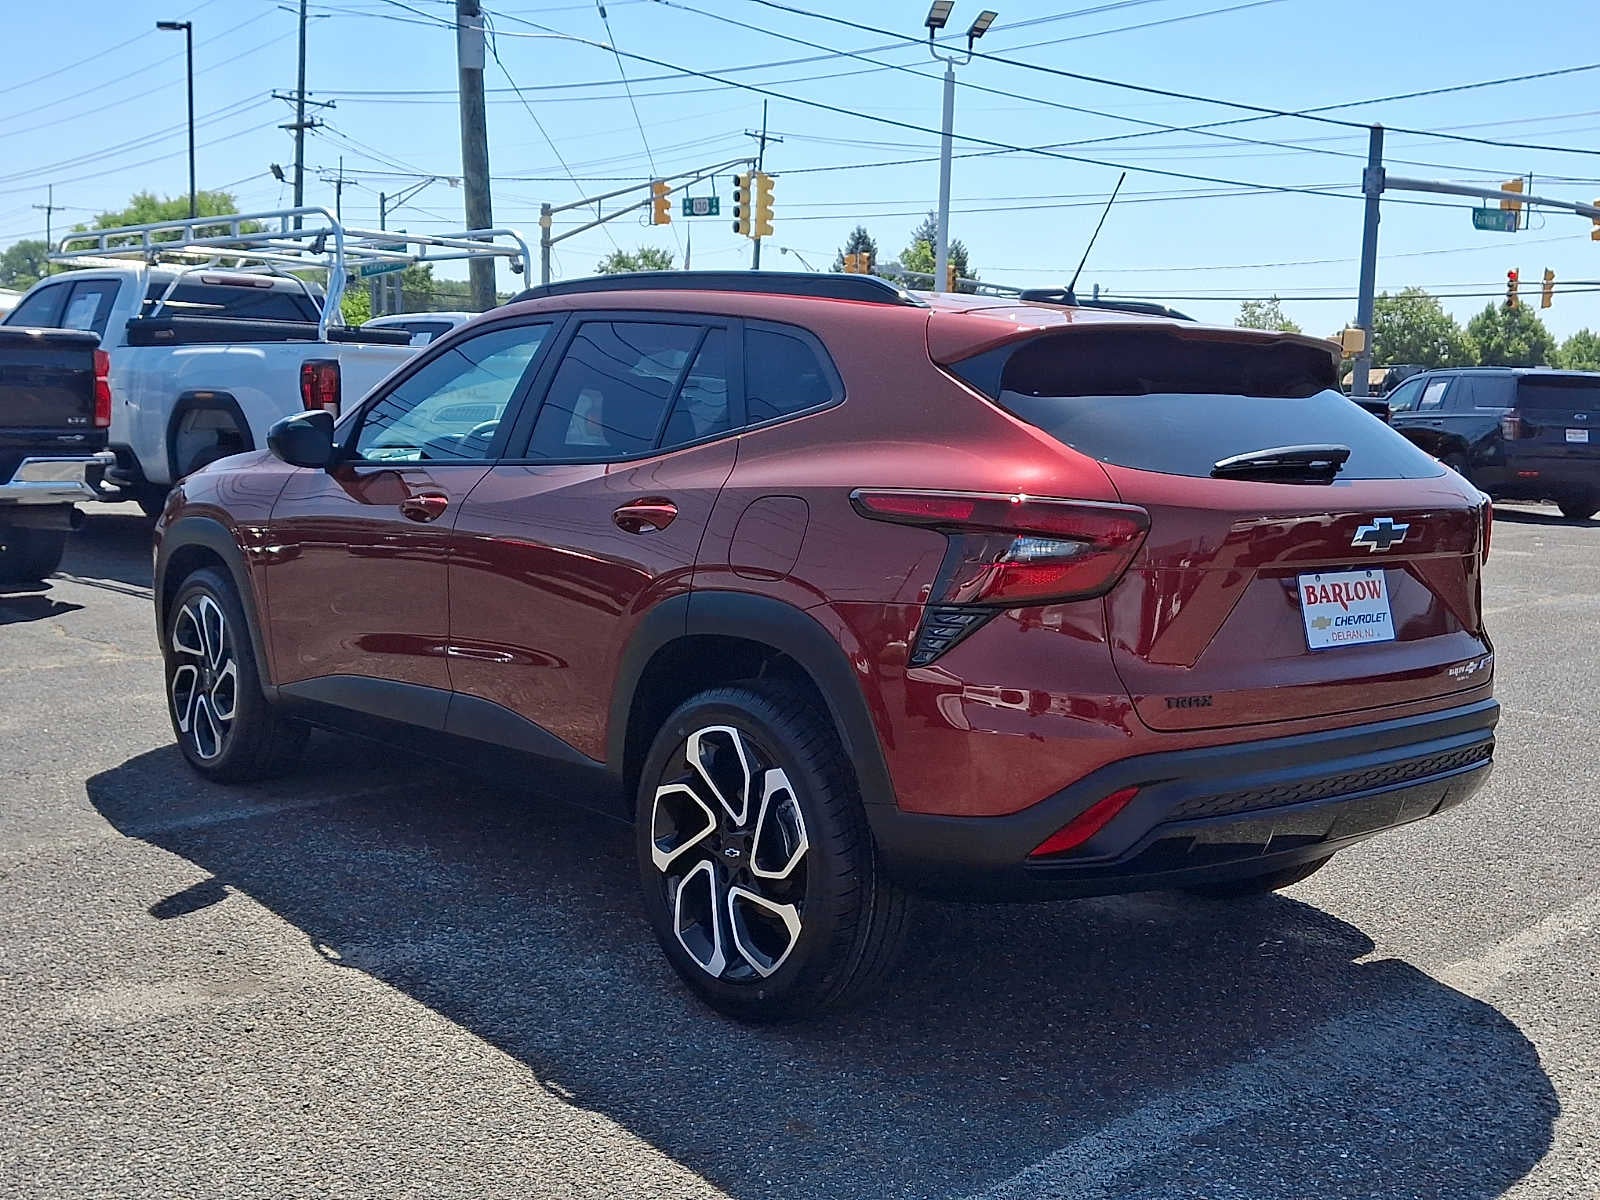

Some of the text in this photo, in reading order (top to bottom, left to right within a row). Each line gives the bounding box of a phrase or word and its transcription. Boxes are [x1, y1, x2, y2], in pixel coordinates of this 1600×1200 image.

[1304, 580, 1381, 611] BARLOW
[1334, 612, 1387, 627] CHEVROLET
[1164, 695, 1212, 709] TRAX
